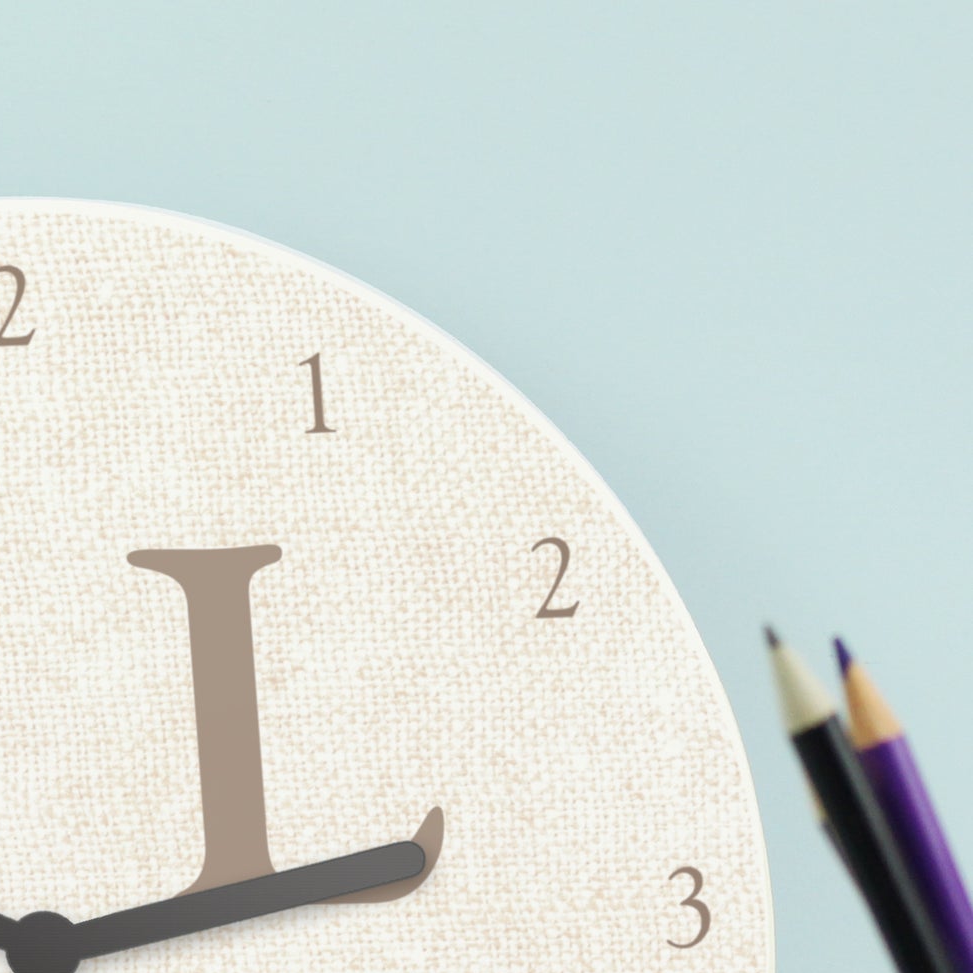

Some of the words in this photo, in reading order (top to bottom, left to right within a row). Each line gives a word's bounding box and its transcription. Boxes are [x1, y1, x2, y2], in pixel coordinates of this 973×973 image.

[298, 353, 336, 435] 1
[530, 536, 580, 620] 2
[127, 541, 444, 906] L
[666, 865, 712, 950] 3
